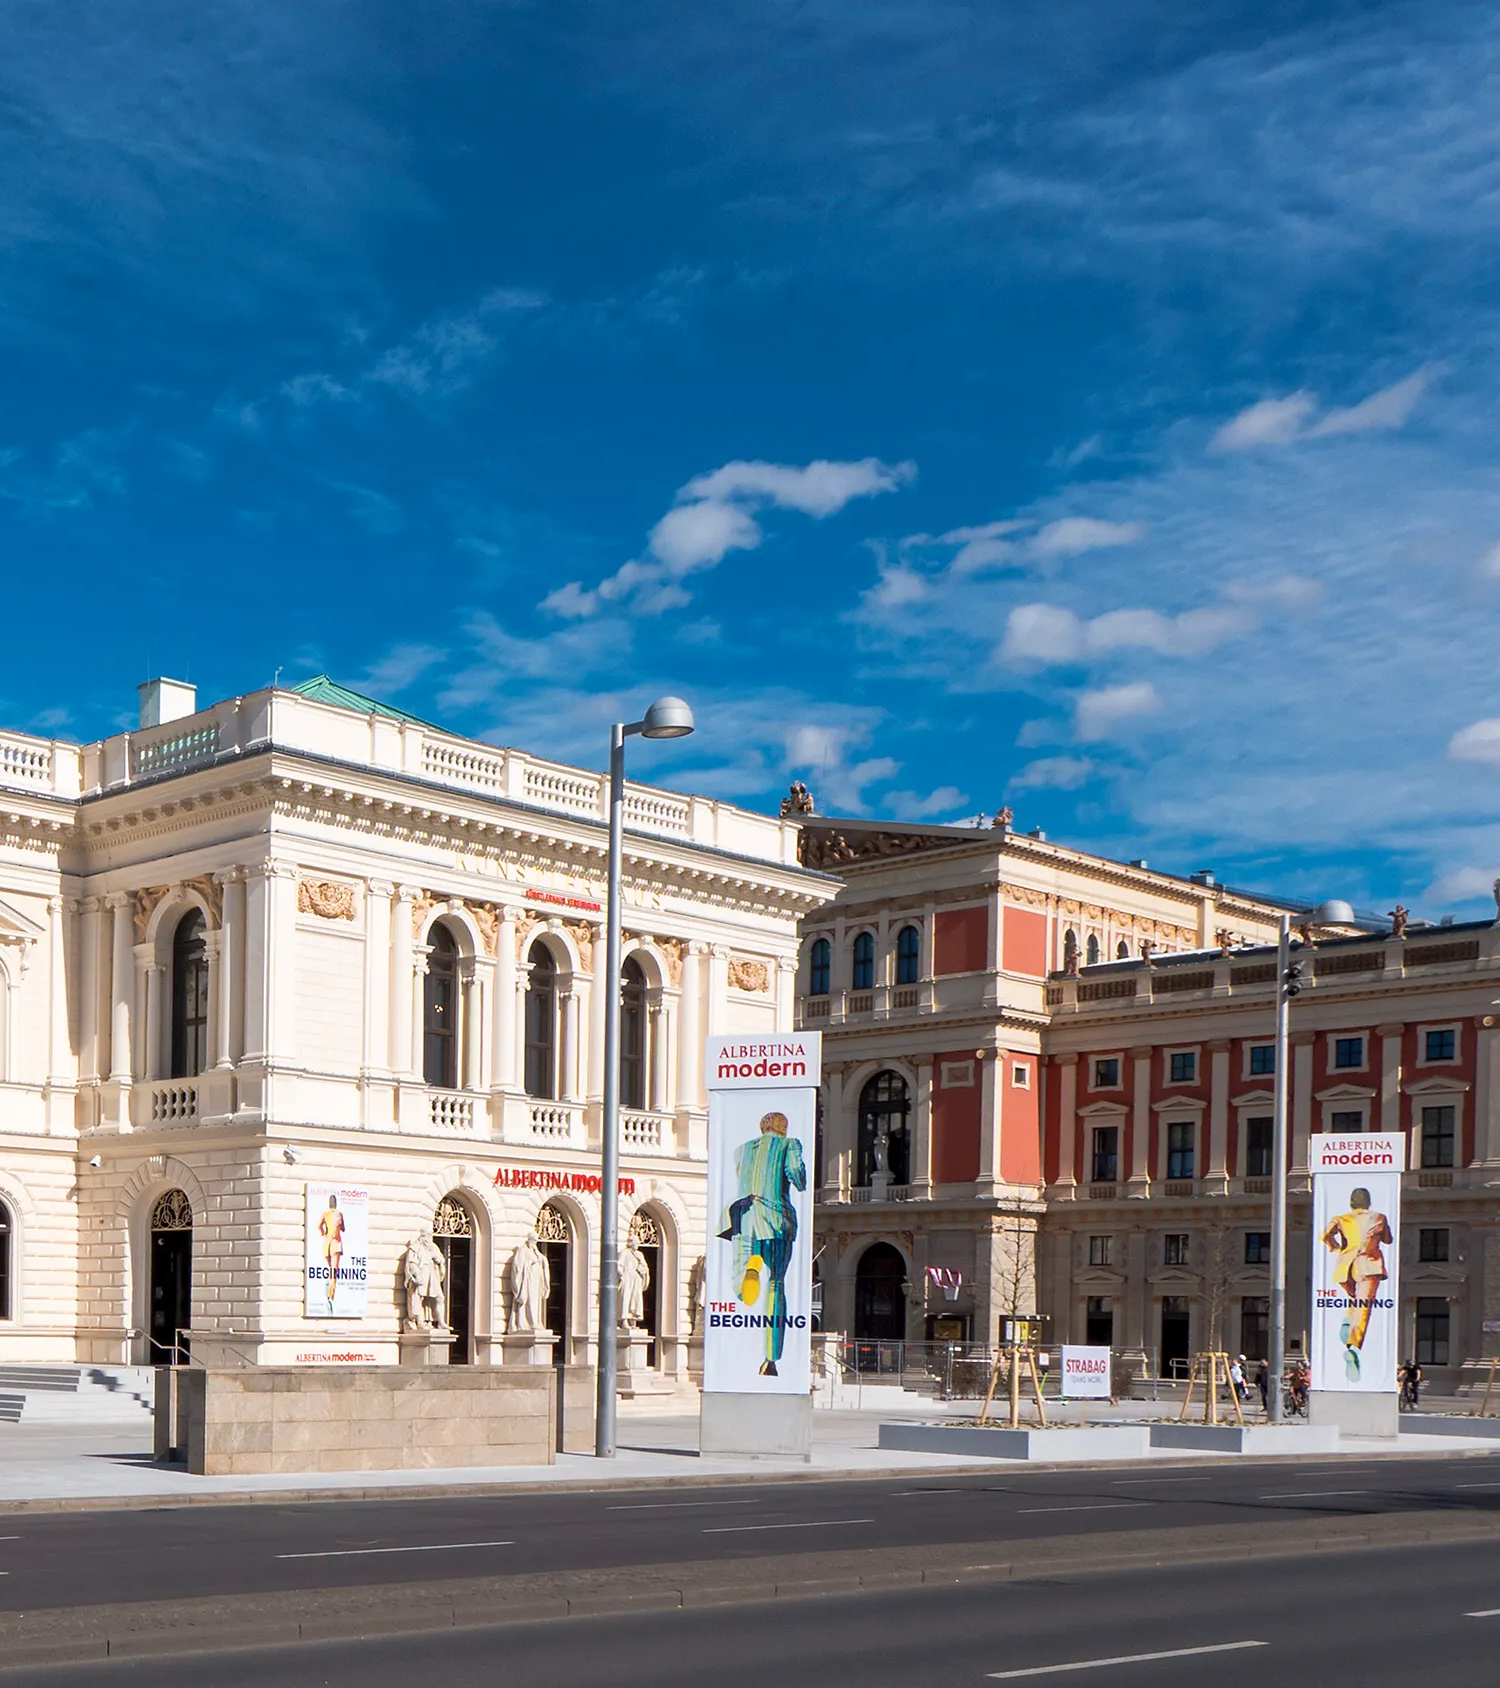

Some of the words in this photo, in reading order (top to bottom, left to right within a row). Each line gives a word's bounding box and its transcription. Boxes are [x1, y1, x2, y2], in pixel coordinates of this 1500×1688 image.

[719, 1044, 805, 1058] ALBERTINA
[718, 1059, 806, 1078] modern
[1323, 1141, 1392, 1151] ALBERTINA
[1322, 1151, 1392, 1165] modern
[494, 1168, 570, 1189] ALBERTINA
[572, 1174, 636, 1195] morn
[341, 1189, 368, 1198] modern
[351, 1256, 367, 1266] THE
[309, 1267, 367, 1280] BEGINNING
[710, 1302, 736, 1312] THE
[1317, 1299, 1394, 1308] BEGINNING
[710, 1315, 806, 1328] BEGINNING
[295, 1353, 331, 1362] ALBERTINA
[332, 1352, 363, 1361] modern
[1066, 1359, 1106, 1374] STRABAG
